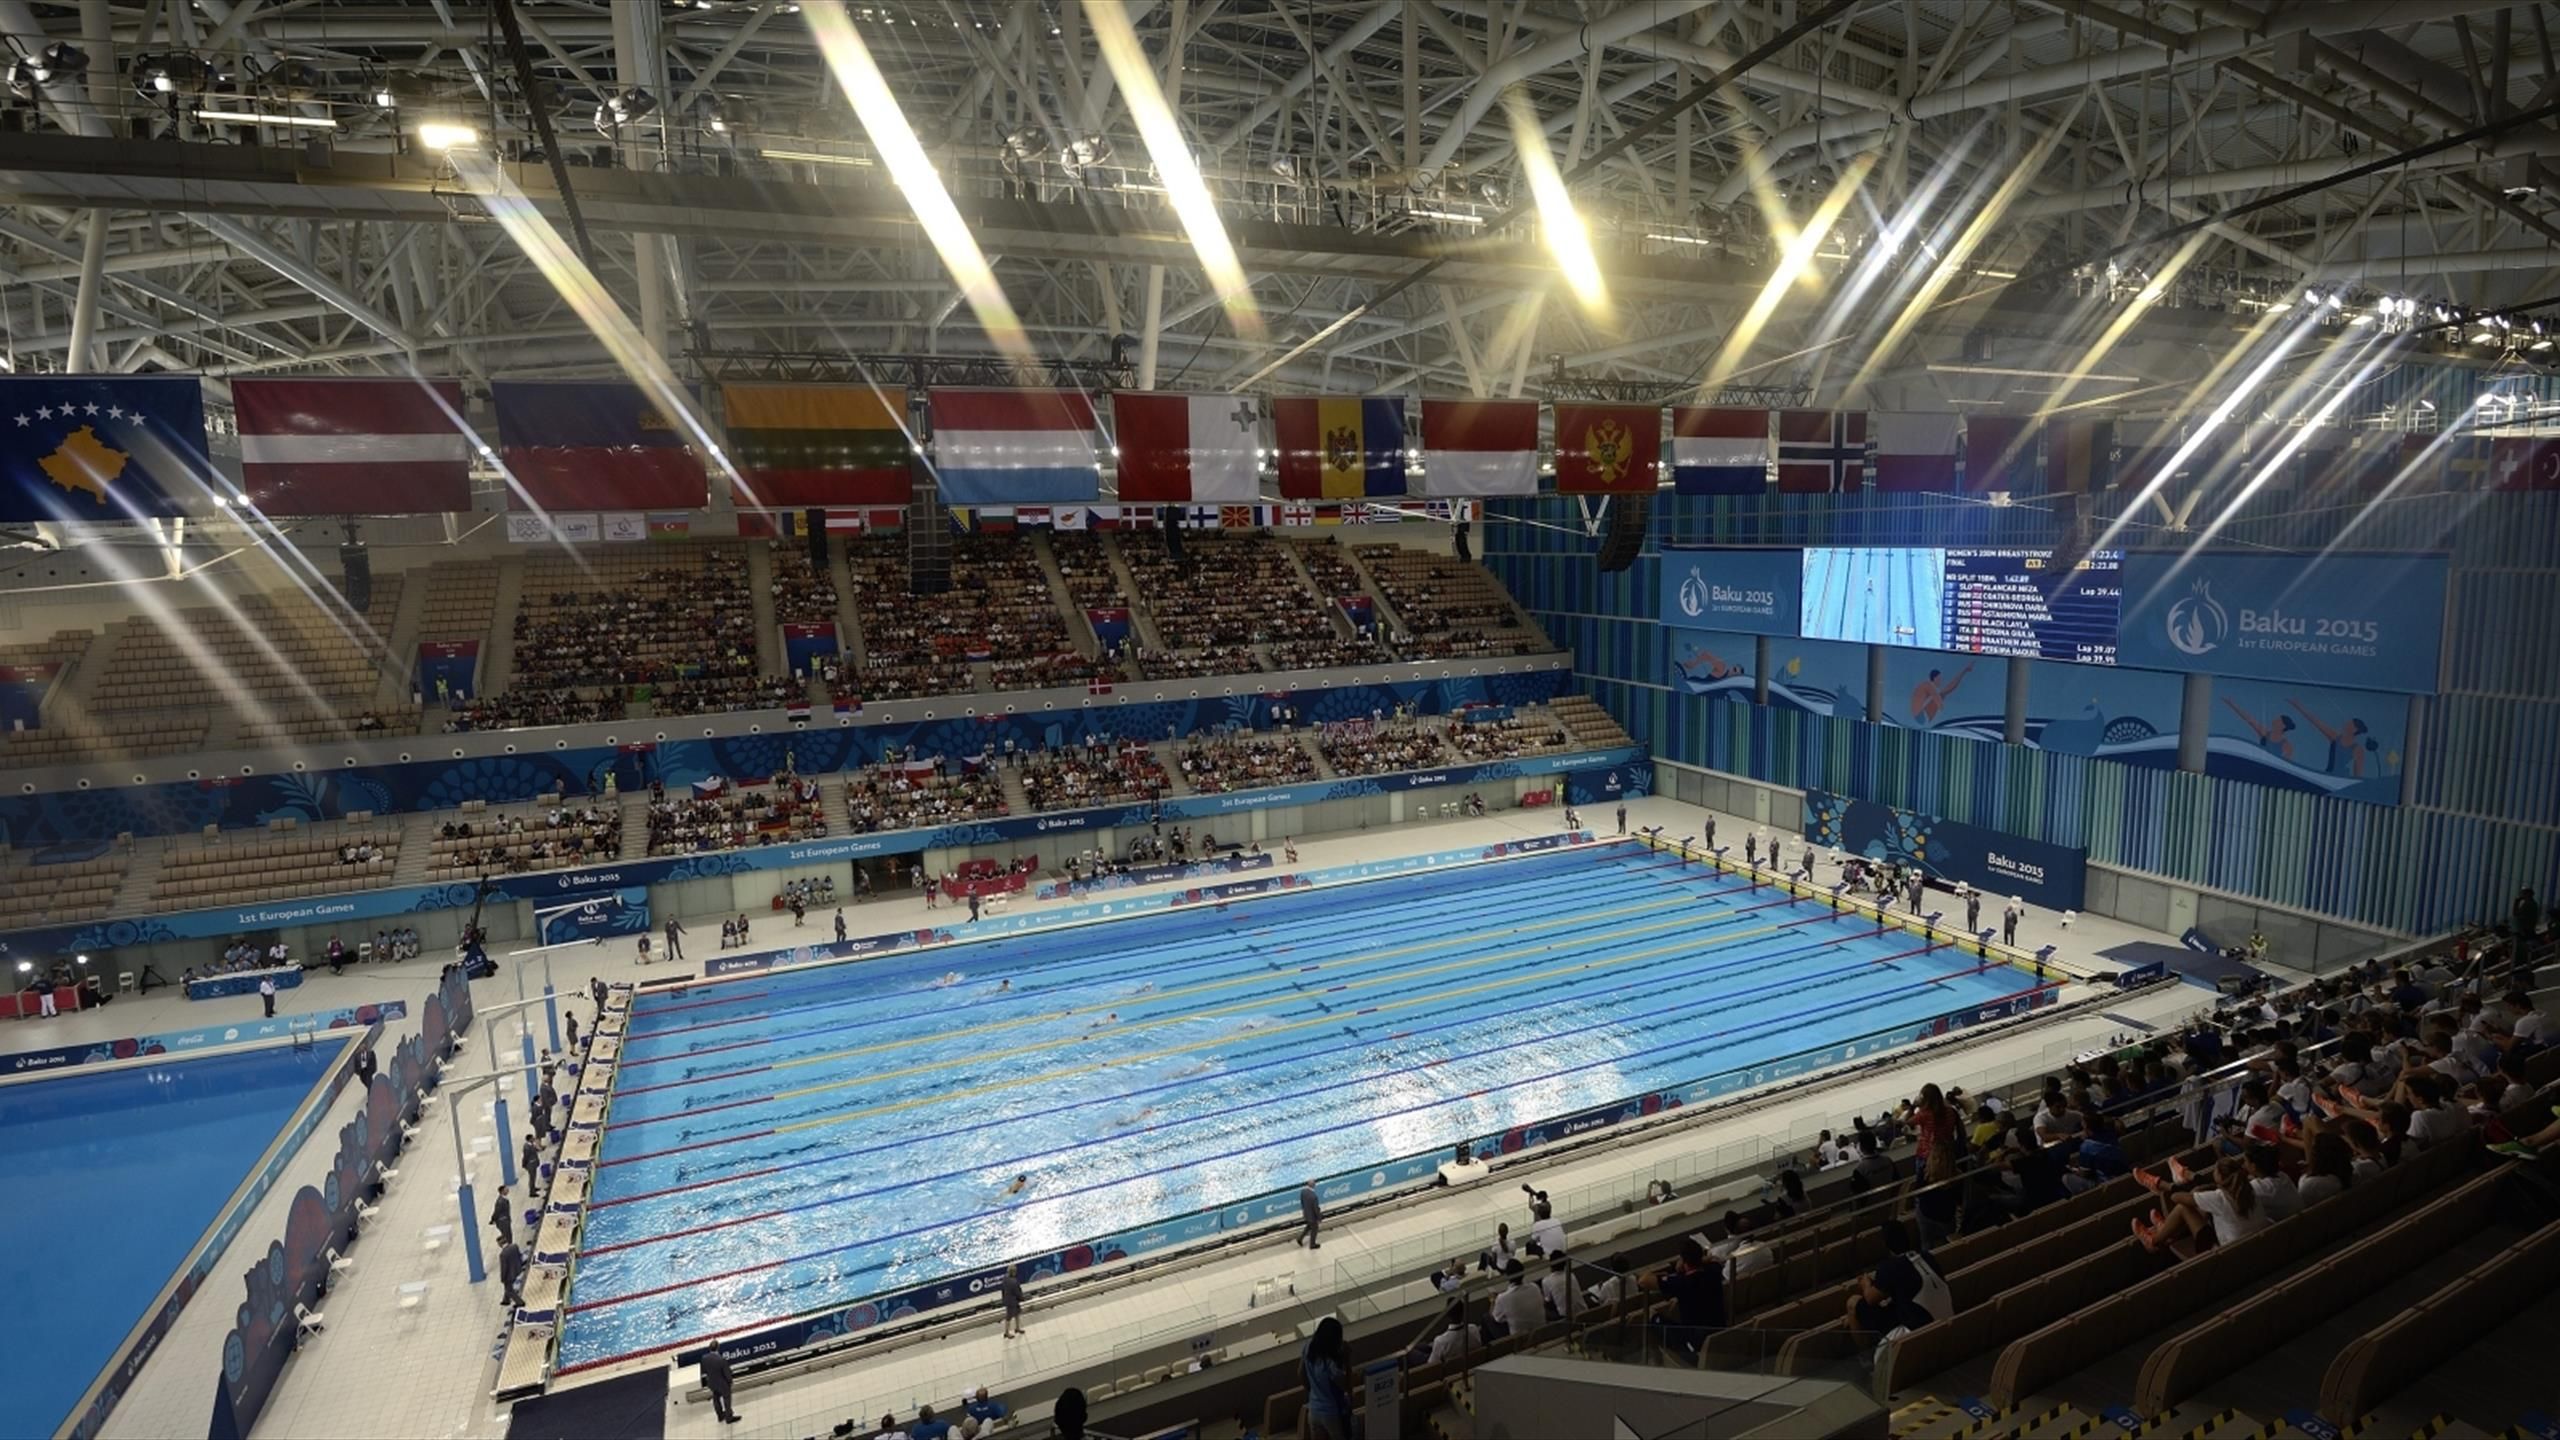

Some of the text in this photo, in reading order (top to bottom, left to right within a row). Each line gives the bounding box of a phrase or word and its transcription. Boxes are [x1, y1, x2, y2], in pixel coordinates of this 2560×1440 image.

[1712, 585, 1774, 606] Baku 2015
[2080, 588, 2096, 596] Lap
[2240, 608, 2378, 642] Baku 2015
[2077, 644, 2092, 653] Lap
[2259, 640, 2327, 653] EUROPEAN
[2330, 644, 2377, 656] GAMES
[790, 842, 881, 859] 1st European Games
[1988, 852, 2044, 878] Baku 2015
[572, 874, 620, 884] Baku 2015
[238, 904, 355, 924] 1st European Games
[722, 1341, 777, 1360] Baku 2015
